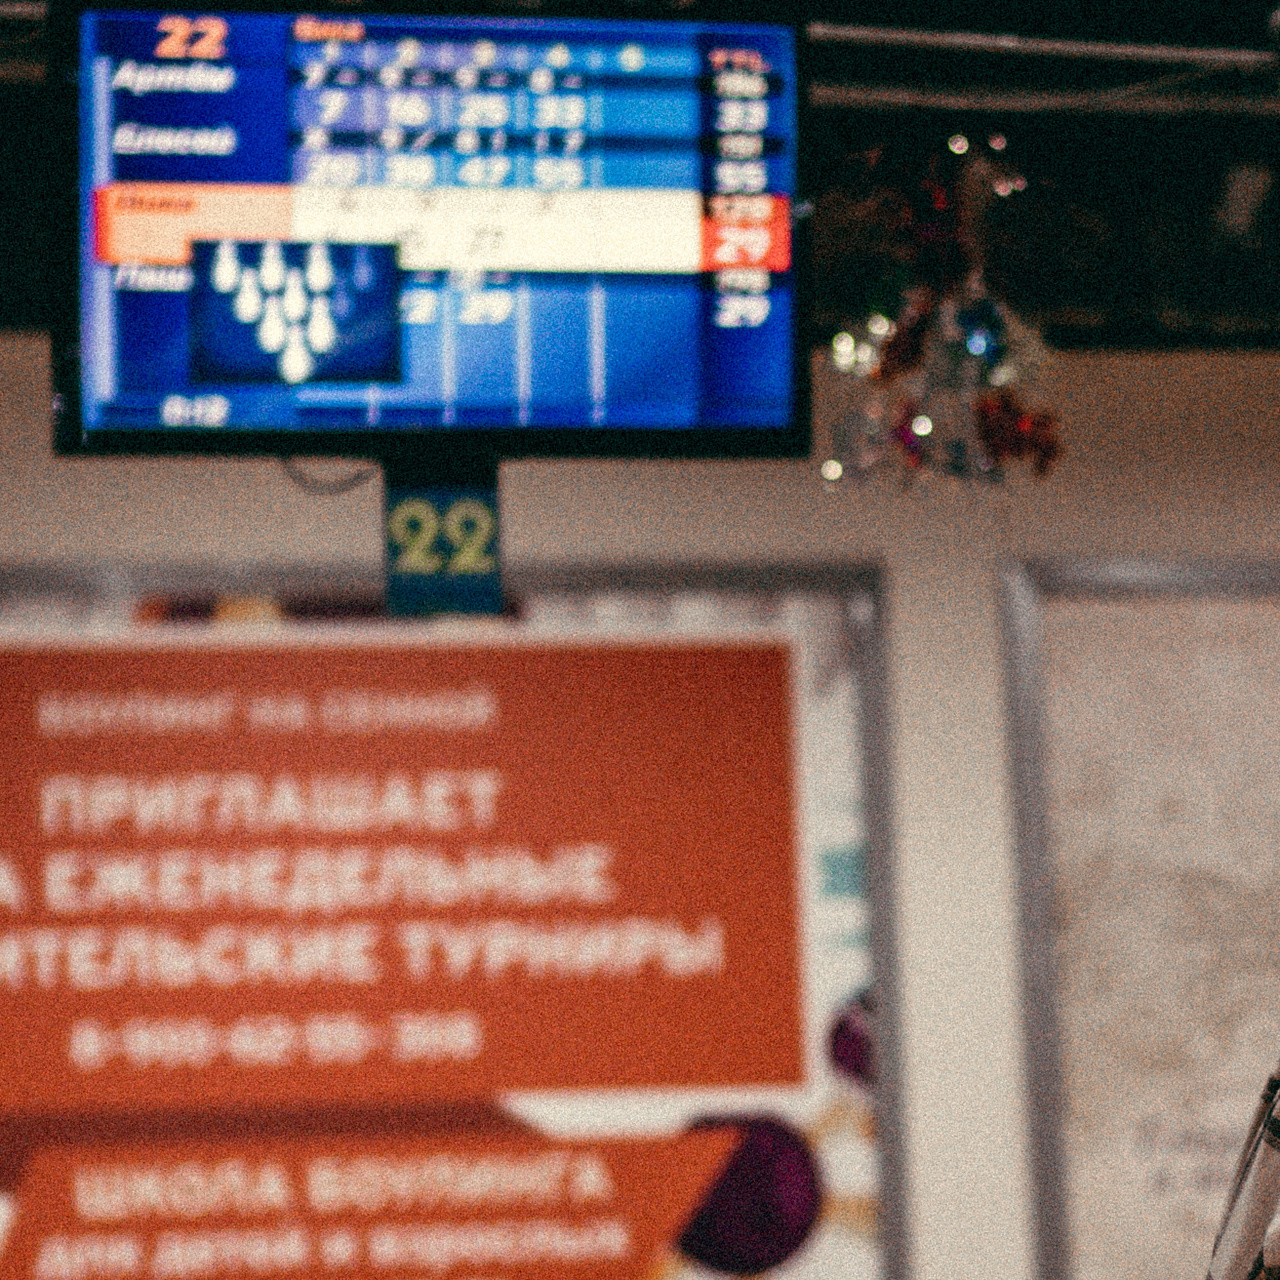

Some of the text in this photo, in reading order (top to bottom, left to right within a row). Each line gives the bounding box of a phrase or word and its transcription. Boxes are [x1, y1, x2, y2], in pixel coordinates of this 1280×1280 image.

[155, 15, 229, 59] 22
[389, 497, 495, 575] 22
[40, 770, 499, 835] ПРИГЛАШАЕТ
[44, 843, 616, 915] ЕЖЕНЕДЕЛЬНЫЕ
[399, 915, 726, 982] ТУРНИРЫ
[74, 1151, 614, 1221] ШКОЛА БОУЛИНГА
